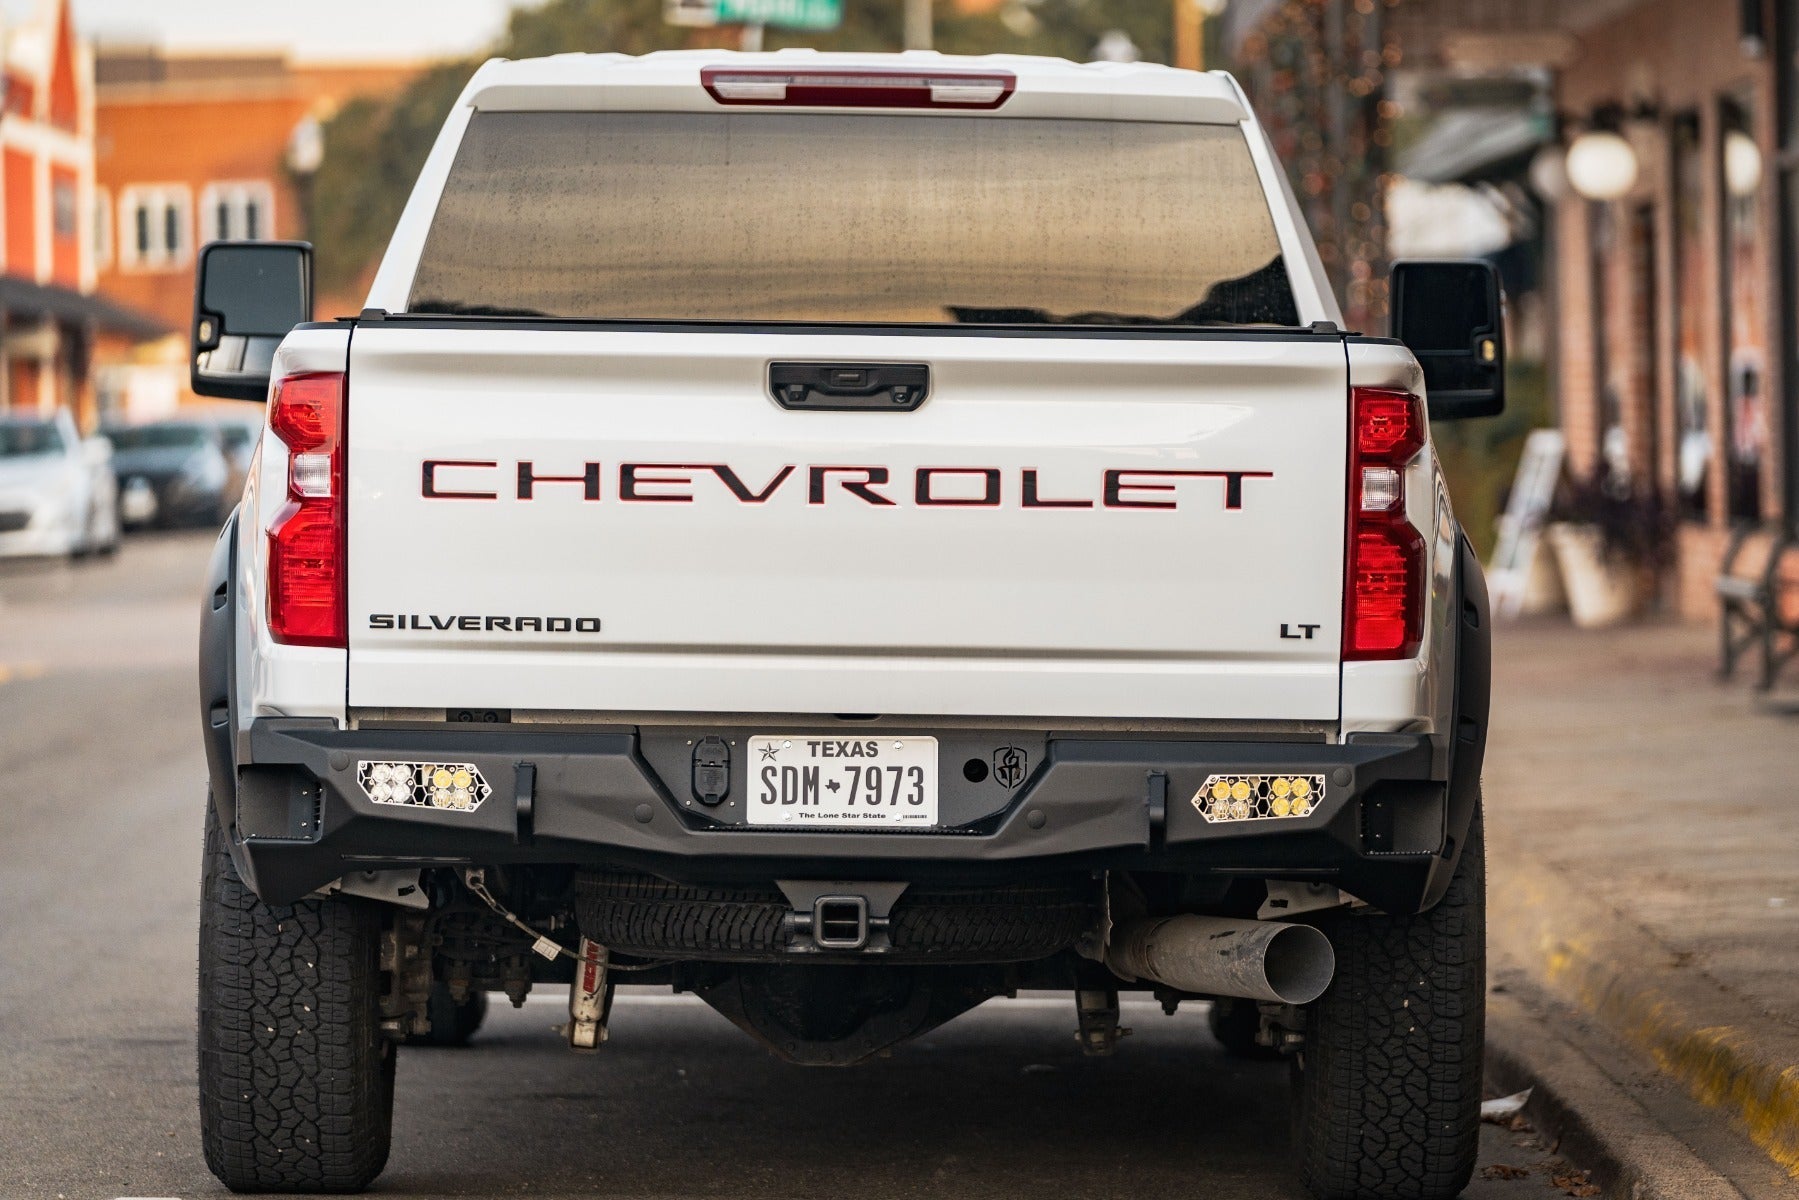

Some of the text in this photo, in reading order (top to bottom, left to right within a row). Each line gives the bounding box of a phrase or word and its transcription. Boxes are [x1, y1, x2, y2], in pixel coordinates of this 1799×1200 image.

[421, 459, 1274, 510] CHEVROLET
[369, 613, 601, 633] SILVERADO
[1280, 623, 1321, 639] LT
[807, 740, 879, 758] TEXAS
[760, 765, 820, 806] SDM
[844, 765, 924, 806] 7973
